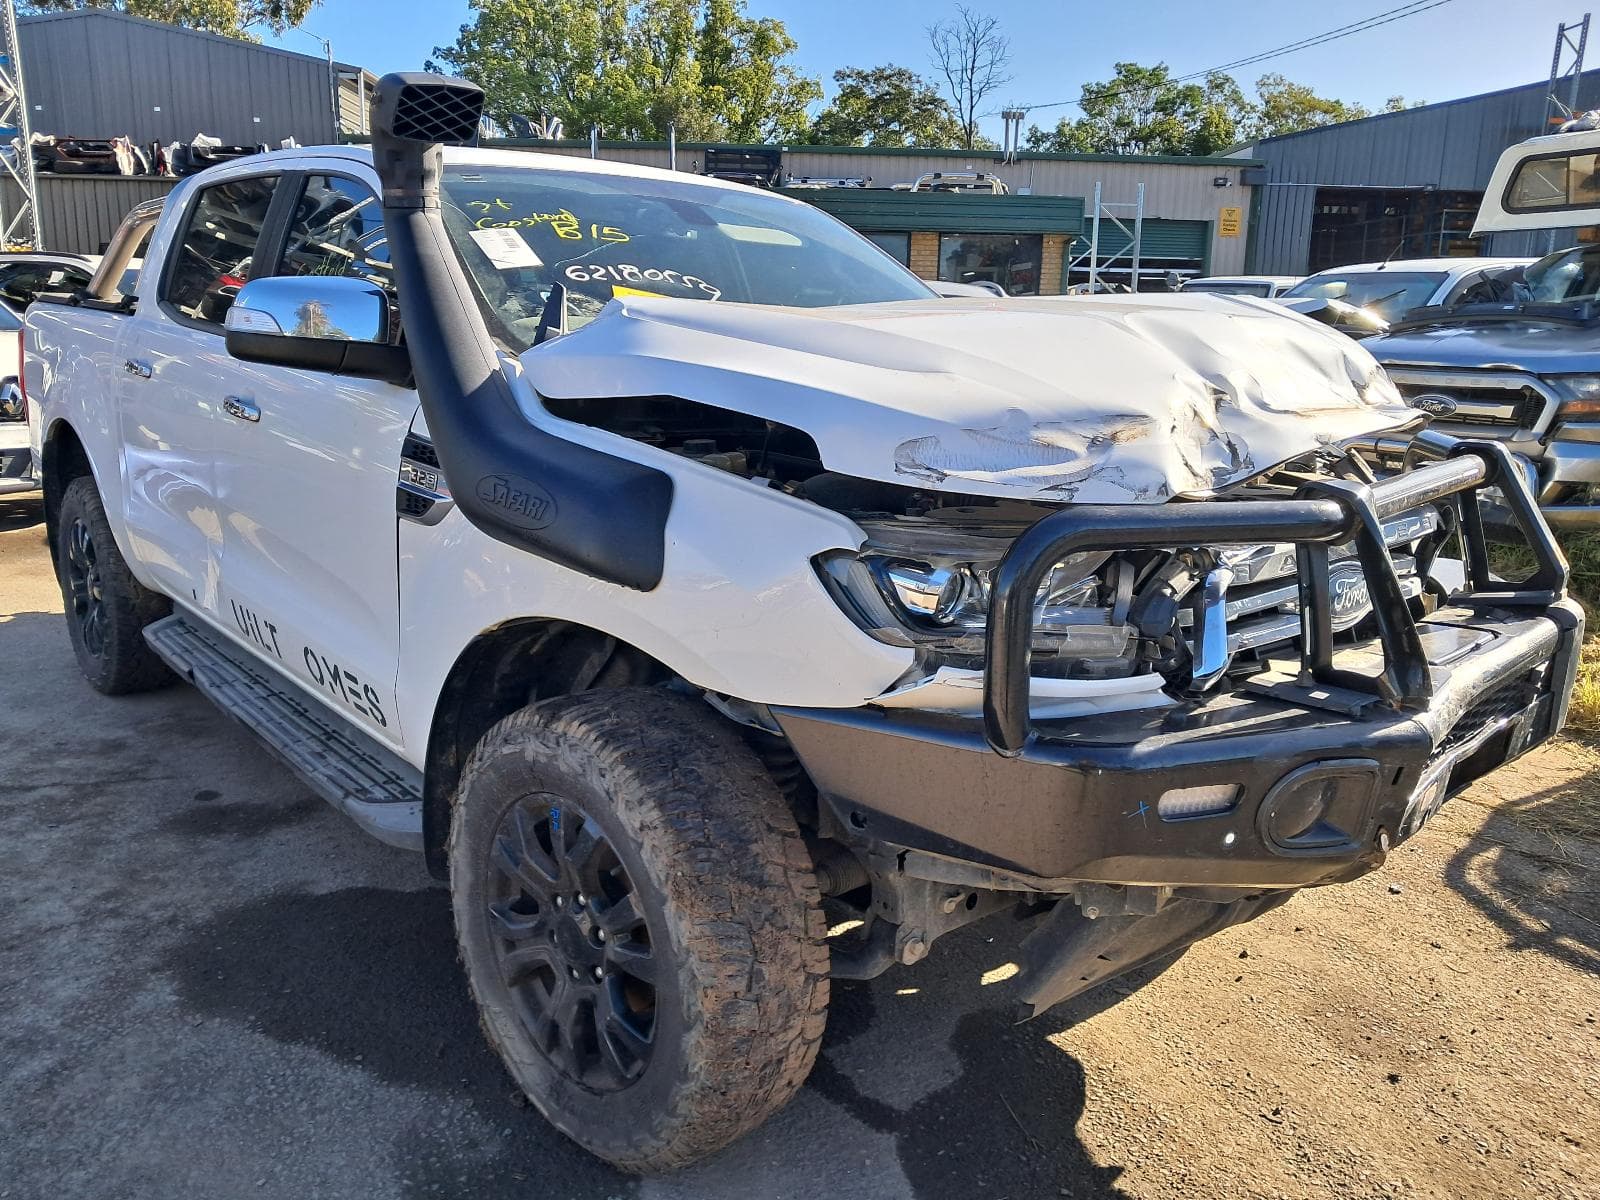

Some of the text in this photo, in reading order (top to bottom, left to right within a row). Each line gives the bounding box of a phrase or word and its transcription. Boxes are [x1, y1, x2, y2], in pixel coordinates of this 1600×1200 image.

[1420, 399, 1444, 411] Ford
[482, 475, 551, 521] SAFARI
[1334, 576, 1369, 611] Ford
[303, 646, 388, 728] OMES
